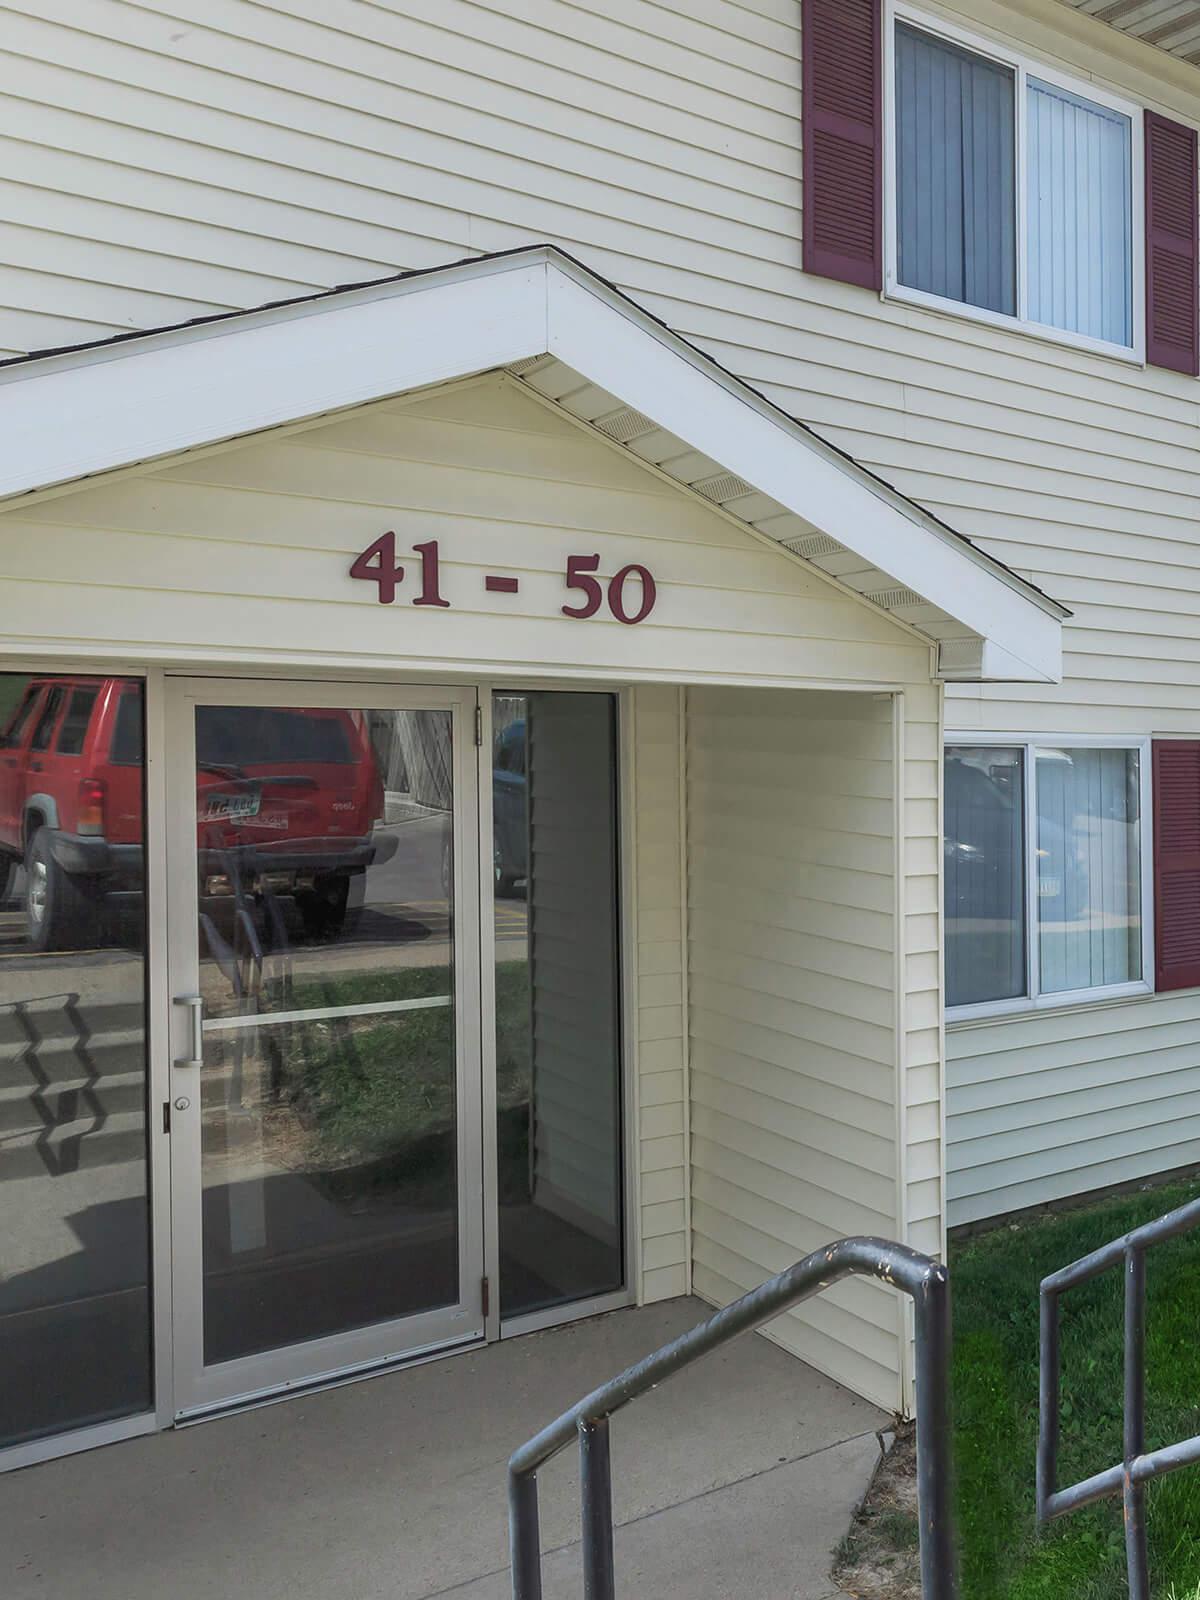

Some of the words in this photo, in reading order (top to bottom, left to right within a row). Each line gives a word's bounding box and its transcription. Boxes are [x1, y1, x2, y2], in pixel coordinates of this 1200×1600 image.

[349, 531, 450, 607] 41
[485, 575, 518, 593] -
[561, 553, 657, 625] 50
